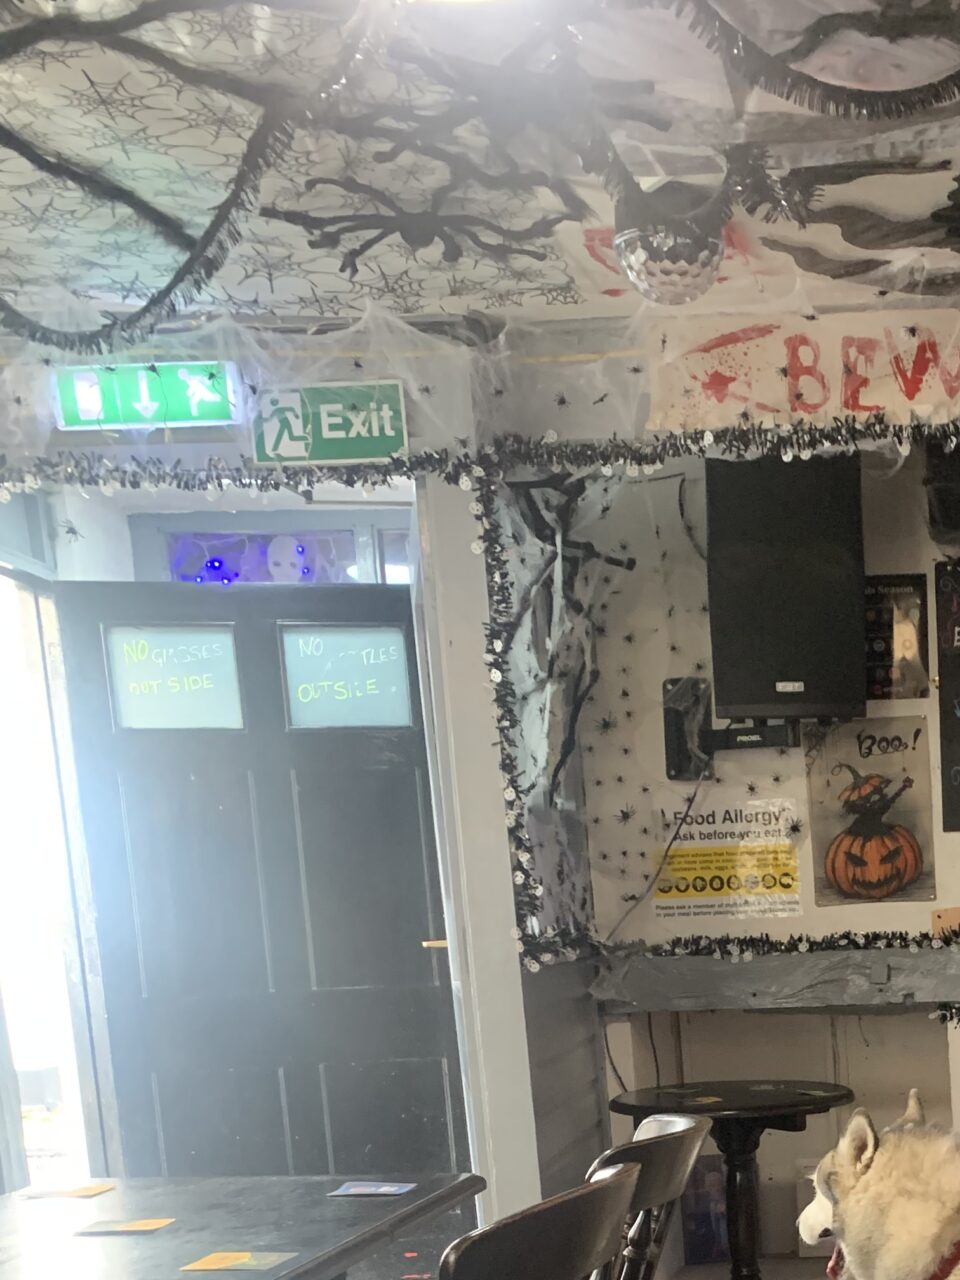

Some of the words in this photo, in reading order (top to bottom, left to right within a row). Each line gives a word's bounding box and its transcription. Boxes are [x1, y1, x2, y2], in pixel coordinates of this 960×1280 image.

[320, 402, 395, 438] Exit
[123, 639, 149, 664] NO
[298, 636, 324, 657] NO
[736, 734, 763, 743] PROEL
[673, 809, 717, 827] Food
[672, 830, 696, 842] Ask
[698, 828, 736, 841] before
